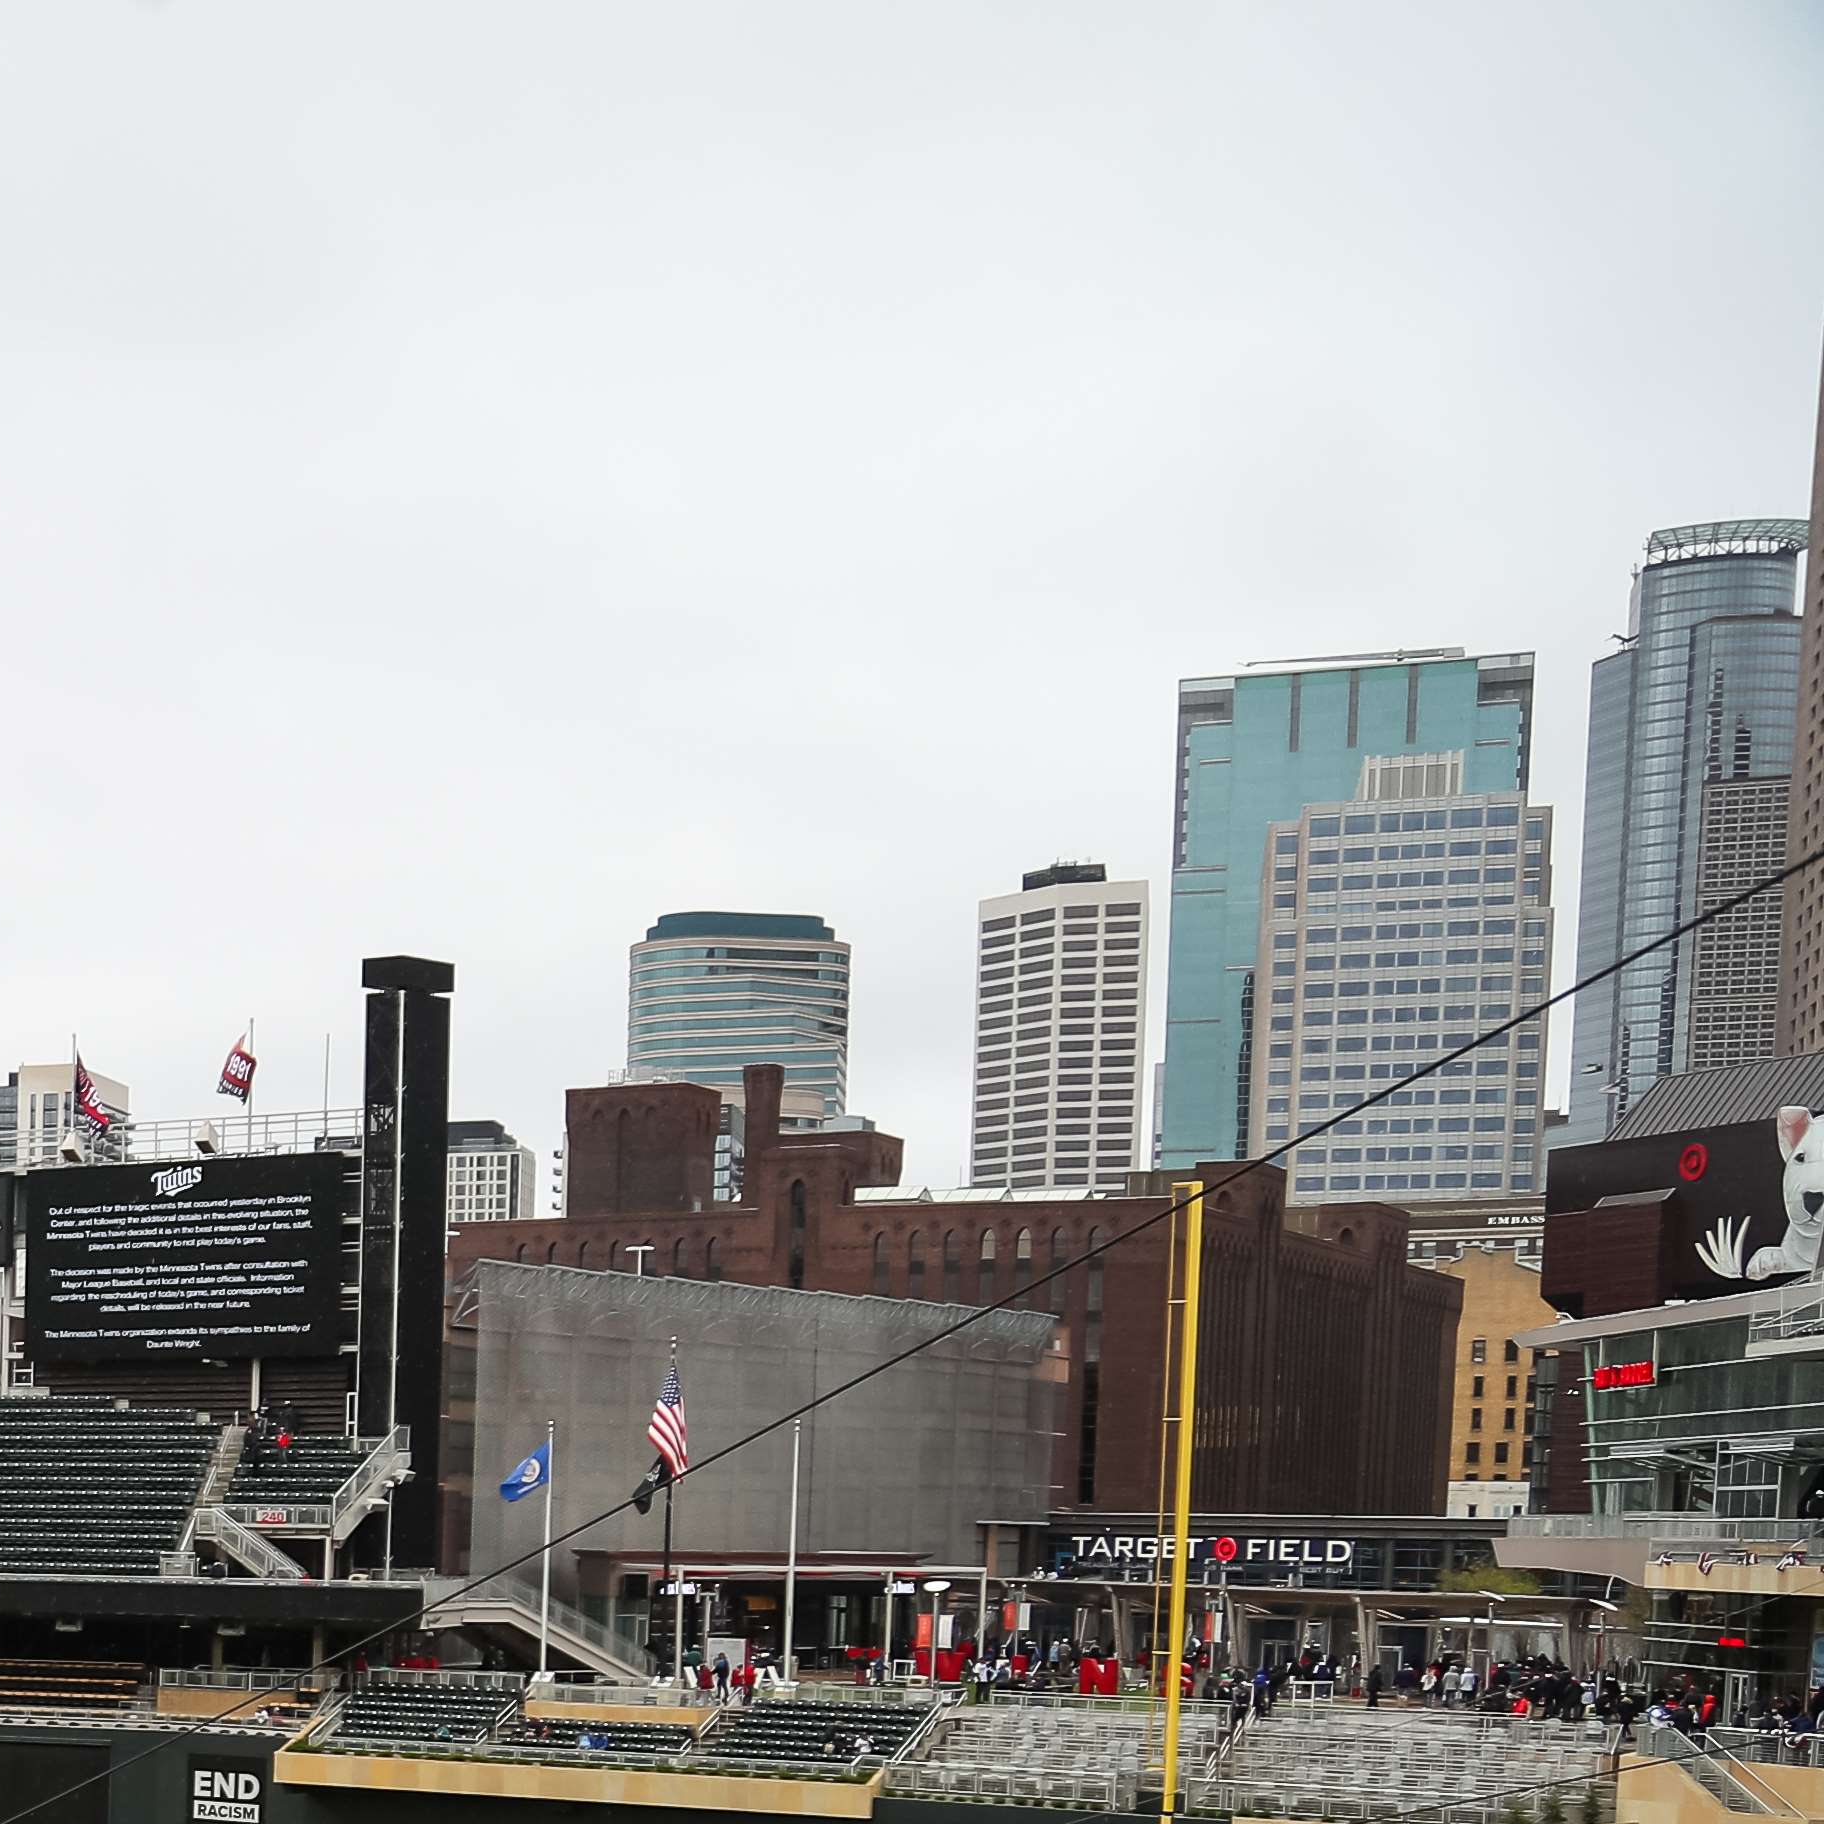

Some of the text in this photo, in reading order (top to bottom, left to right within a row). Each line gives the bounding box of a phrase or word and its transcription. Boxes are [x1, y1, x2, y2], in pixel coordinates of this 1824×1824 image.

[151, 1165, 203, 1198] Twins
[1247, 1539, 1352, 1562] FIELD
[193, 1770, 260, 1800] END
[197, 1803, 255, 1821] RACISM
